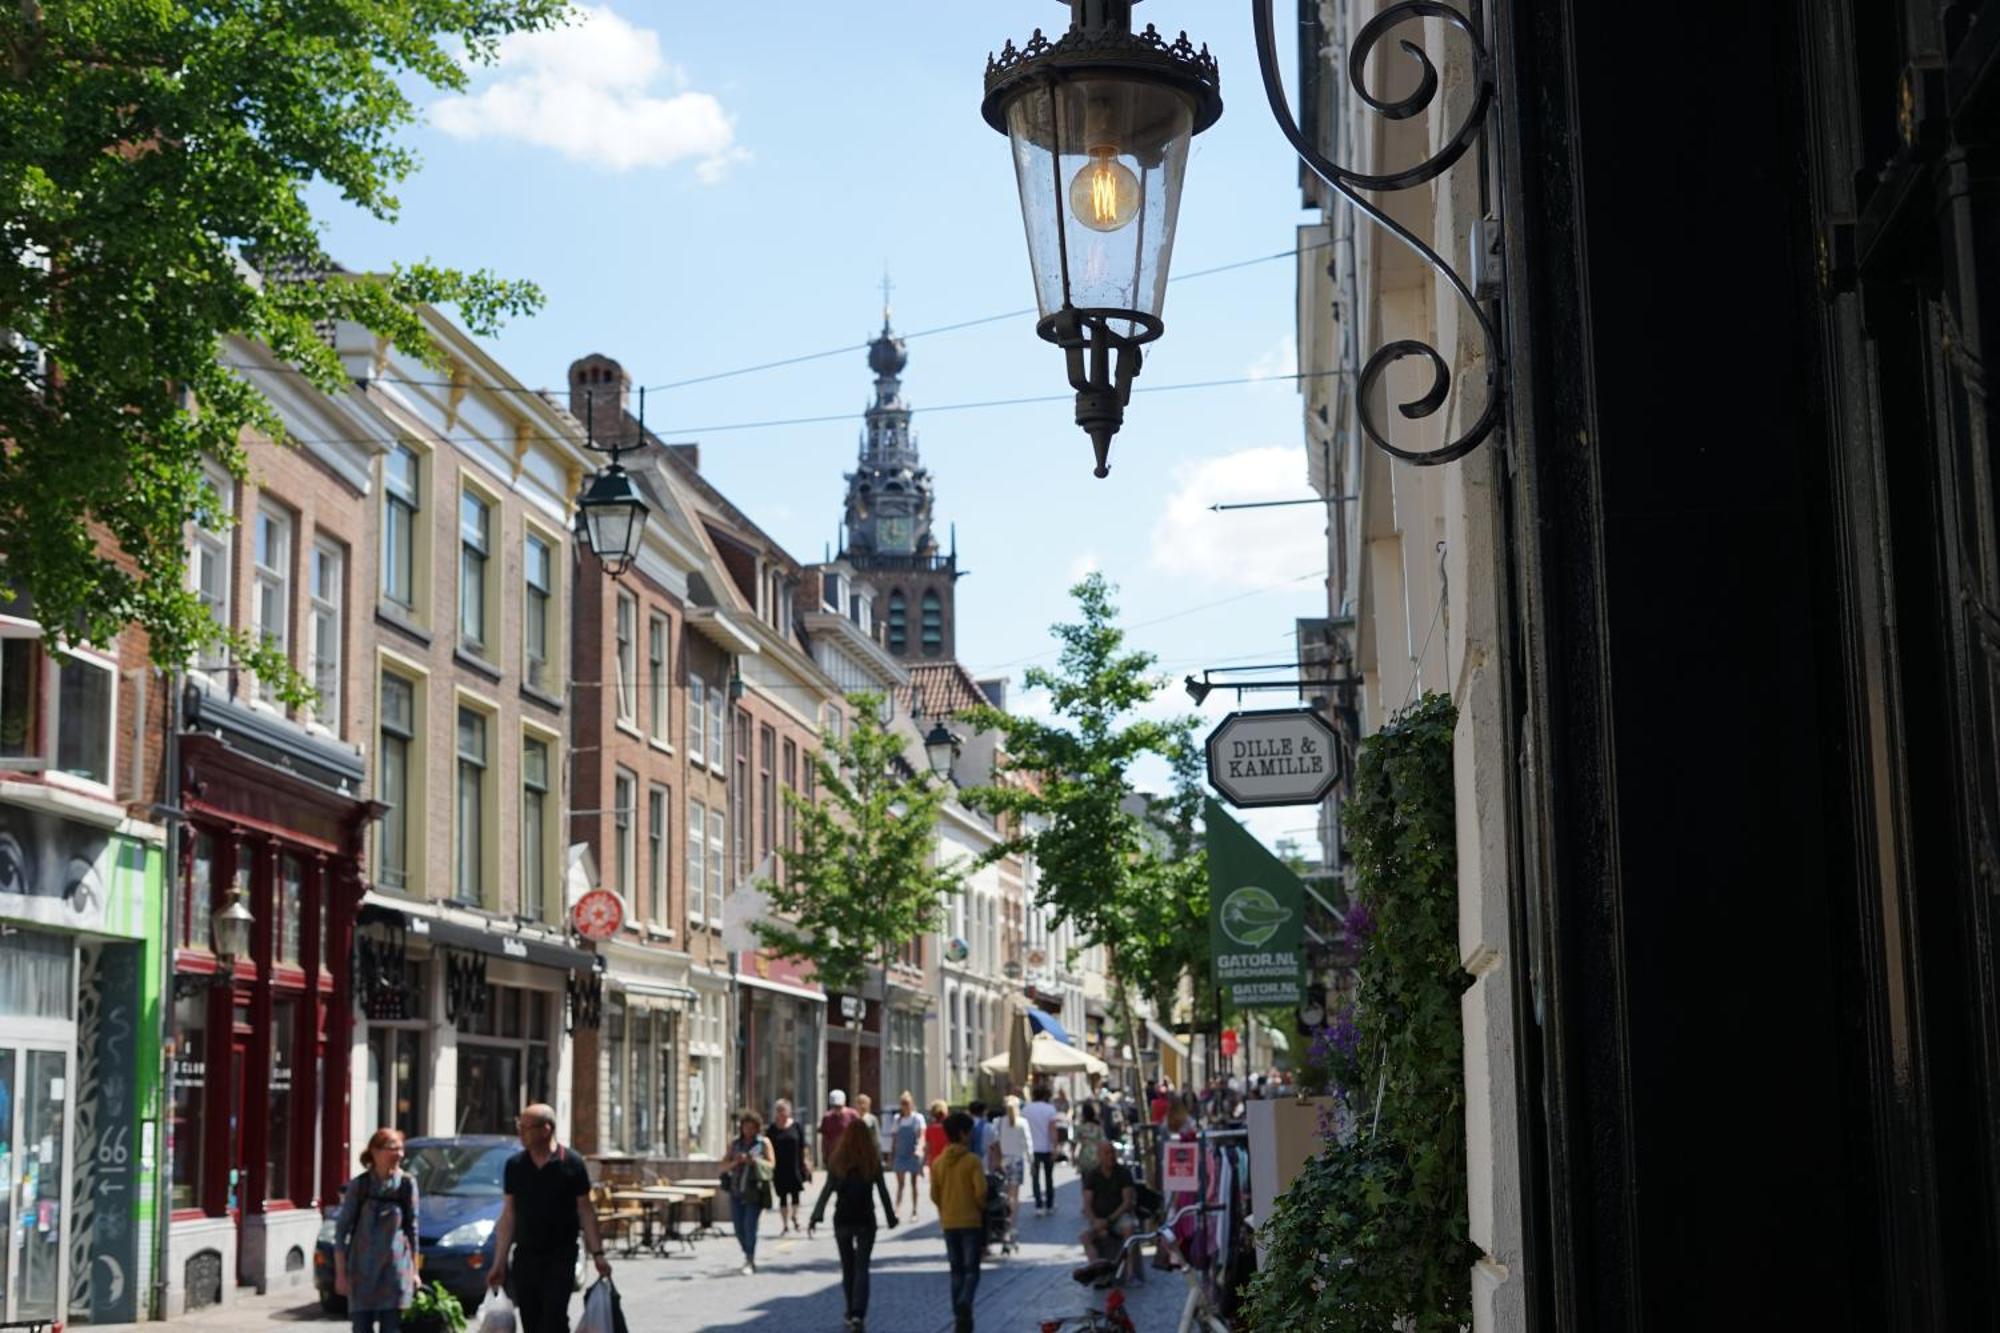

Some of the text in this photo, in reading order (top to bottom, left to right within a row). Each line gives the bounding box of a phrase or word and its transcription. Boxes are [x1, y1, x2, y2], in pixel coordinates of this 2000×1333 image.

[1232, 736, 1317, 758] DILLE &
[1229, 756, 1323, 778] KAMILLE
[1217, 952, 1299, 969] GATOR.NL
[1232, 982, 1299, 995] GATOR.NL
[99, 1125, 128, 1165] 66
